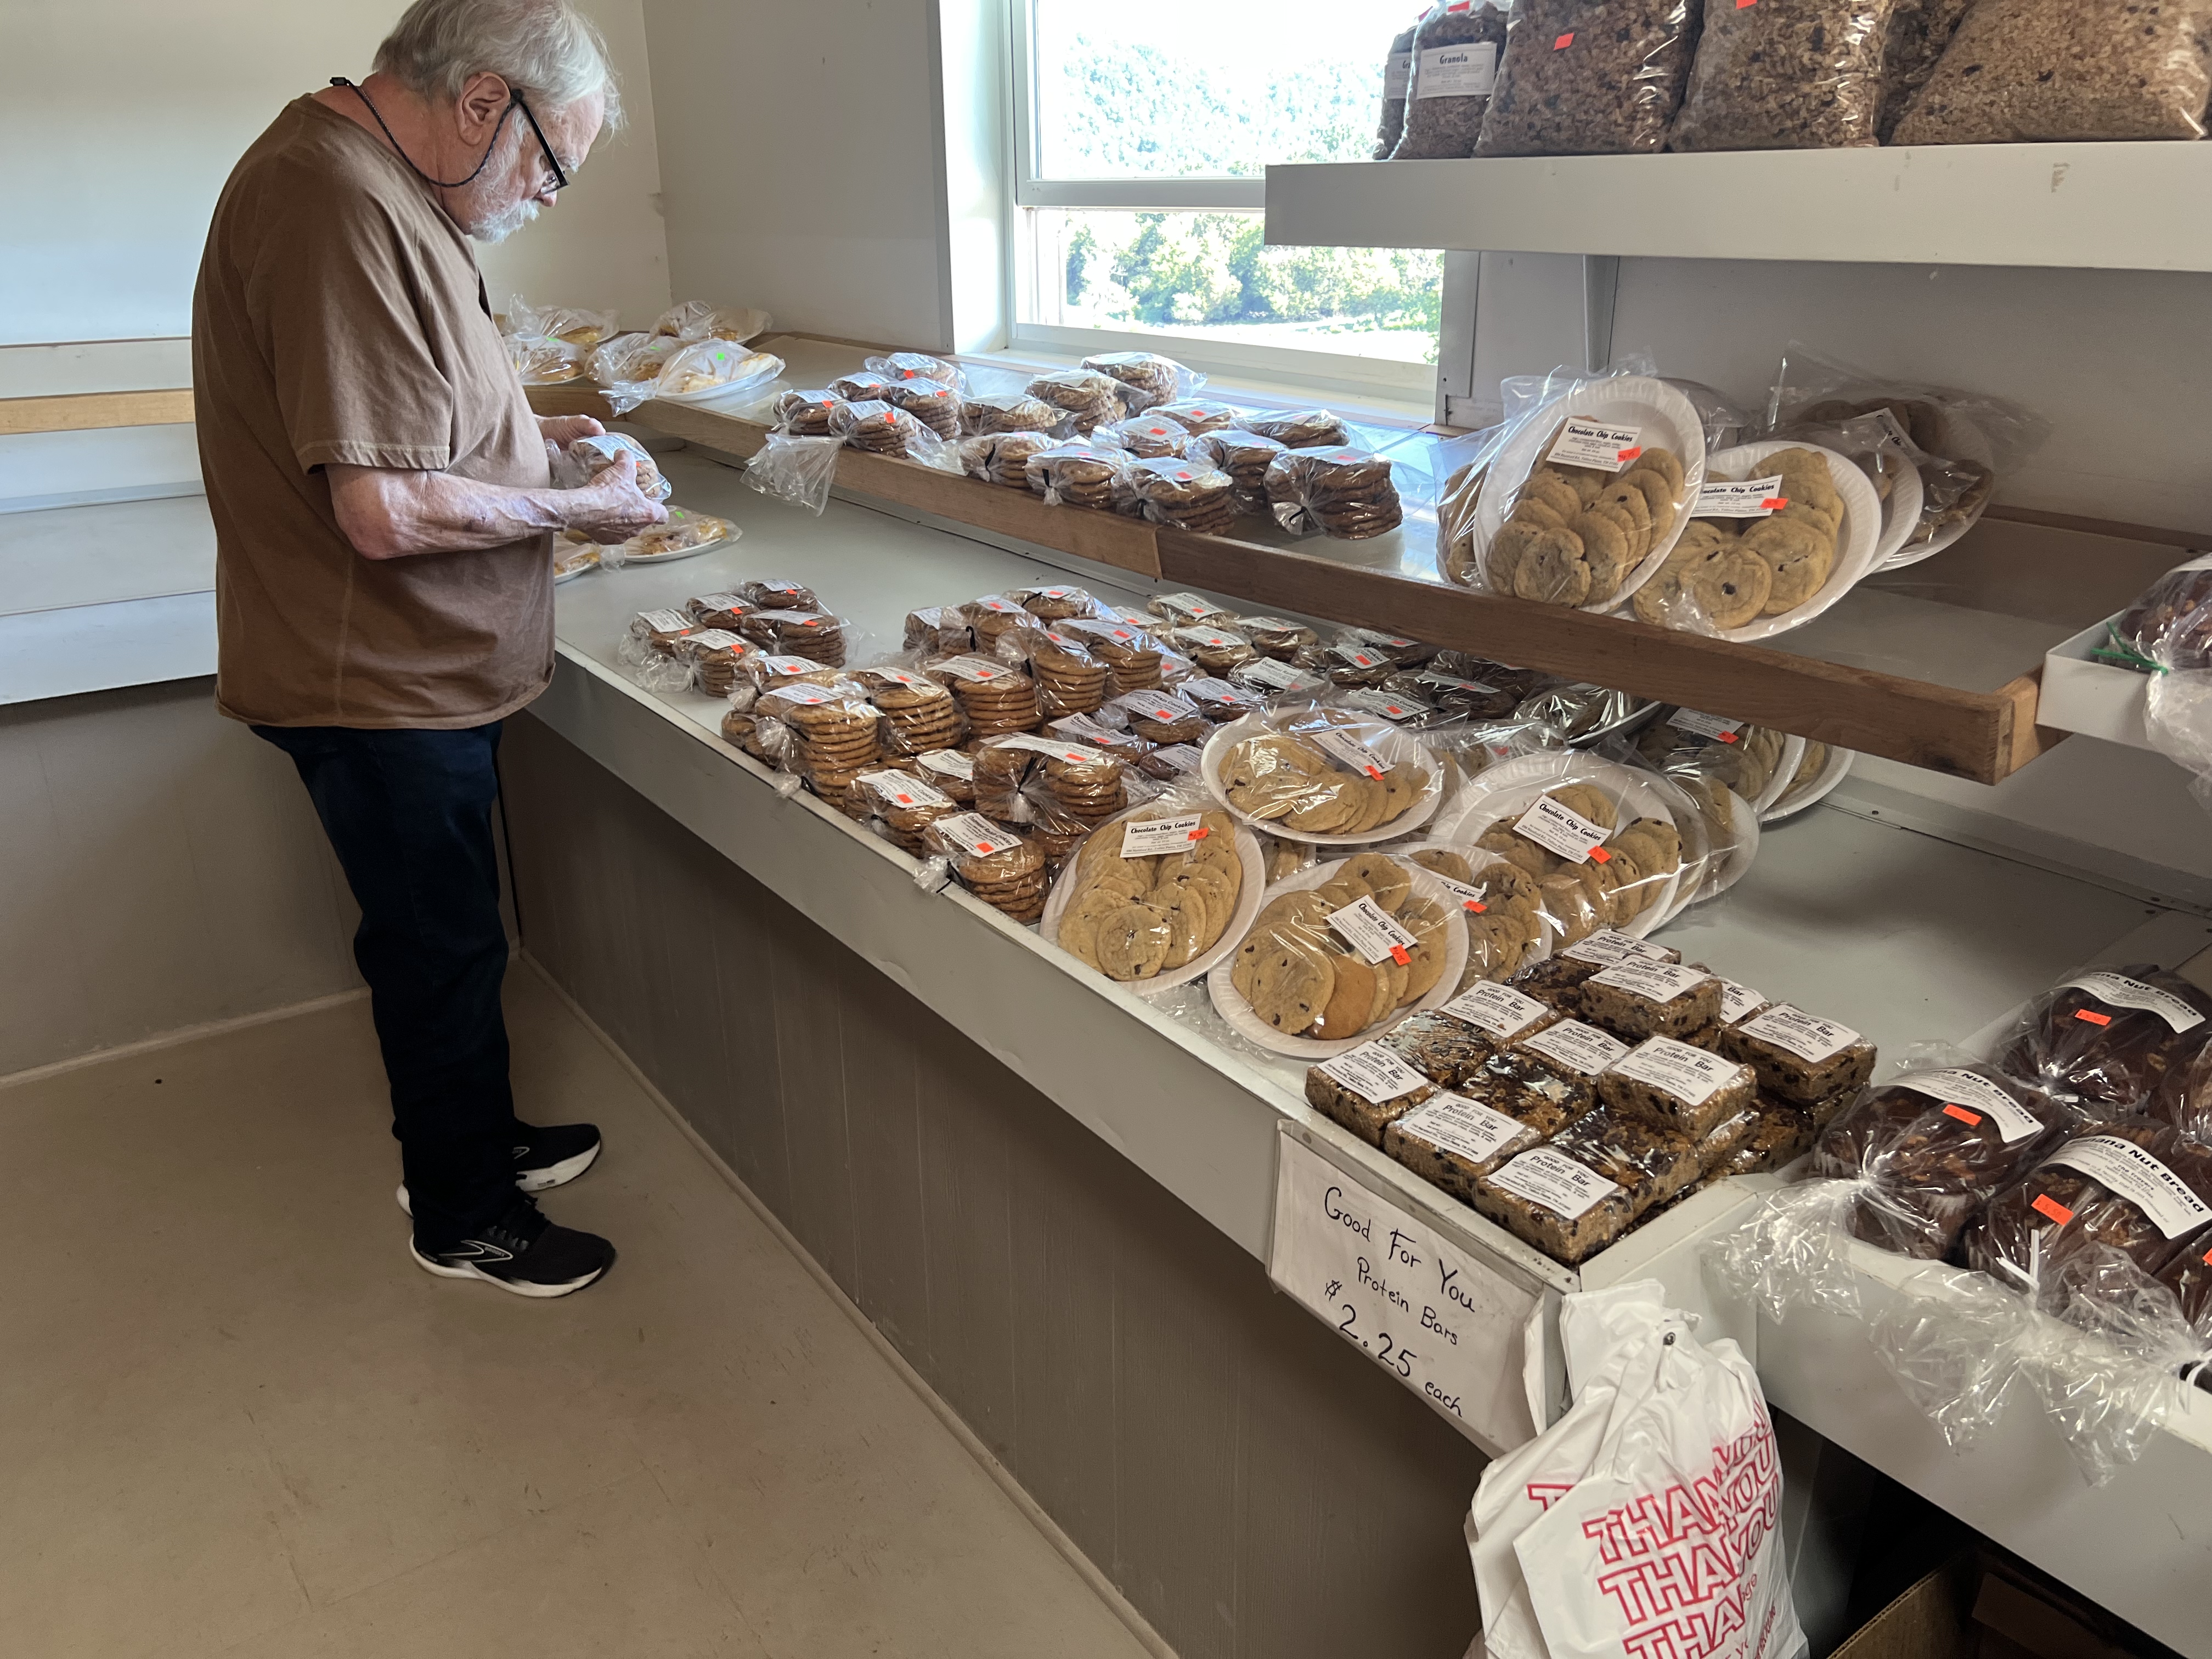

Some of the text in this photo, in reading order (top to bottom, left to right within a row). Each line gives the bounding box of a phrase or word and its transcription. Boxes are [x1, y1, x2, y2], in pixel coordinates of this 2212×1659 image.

[1440, 53, 1468, 65] Granola
[1568, 426, 1633, 442] Chocolate Chip Cookies
[1749, 484, 1775, 493] Cookies
[1152, 693, 1167, 702] Raisin
[1167, 701, 1188, 712] Cookies
[1539, 804, 1601, 840] Chocolate Chip Cookies
[1453, 887, 1475, 897] Cookies
[1359, 903, 1405, 945] Chocolate Chip Cookies
[1597, 936, 1626, 946] Protein
[1626, 962, 1658, 972] Protein
[1476, 989, 1525, 1011] Protein Bar
[1727, 987, 1745, 996] Bar
[2124, 979, 2152, 991] Nut
[2155, 990, 2198, 1016] Bread
[1779, 1013, 1834, 1036] Protein Bar
[1562, 1028, 1615, 1051] Protein Bar
[1359, 1051, 1403, 1080] Protein Bar
[1653, 1047, 1713, 1071] Protein Bar
[1961, 1073, 1991, 1087] Nut
[1993, 1089, 2034, 1124] Bread
[1442, 1105, 1498, 1130] Protein Bar
[1530, 1156, 1590, 1186] Protein Bar
[2128, 1149, 2160, 1171] Nut
[2160, 1172, 2205, 1212] Bread
[1323, 1186, 1476, 1313] Good For You
[1357, 1256, 1458, 1346] Protein Bars
[1424, 1381, 1463, 1418] each
